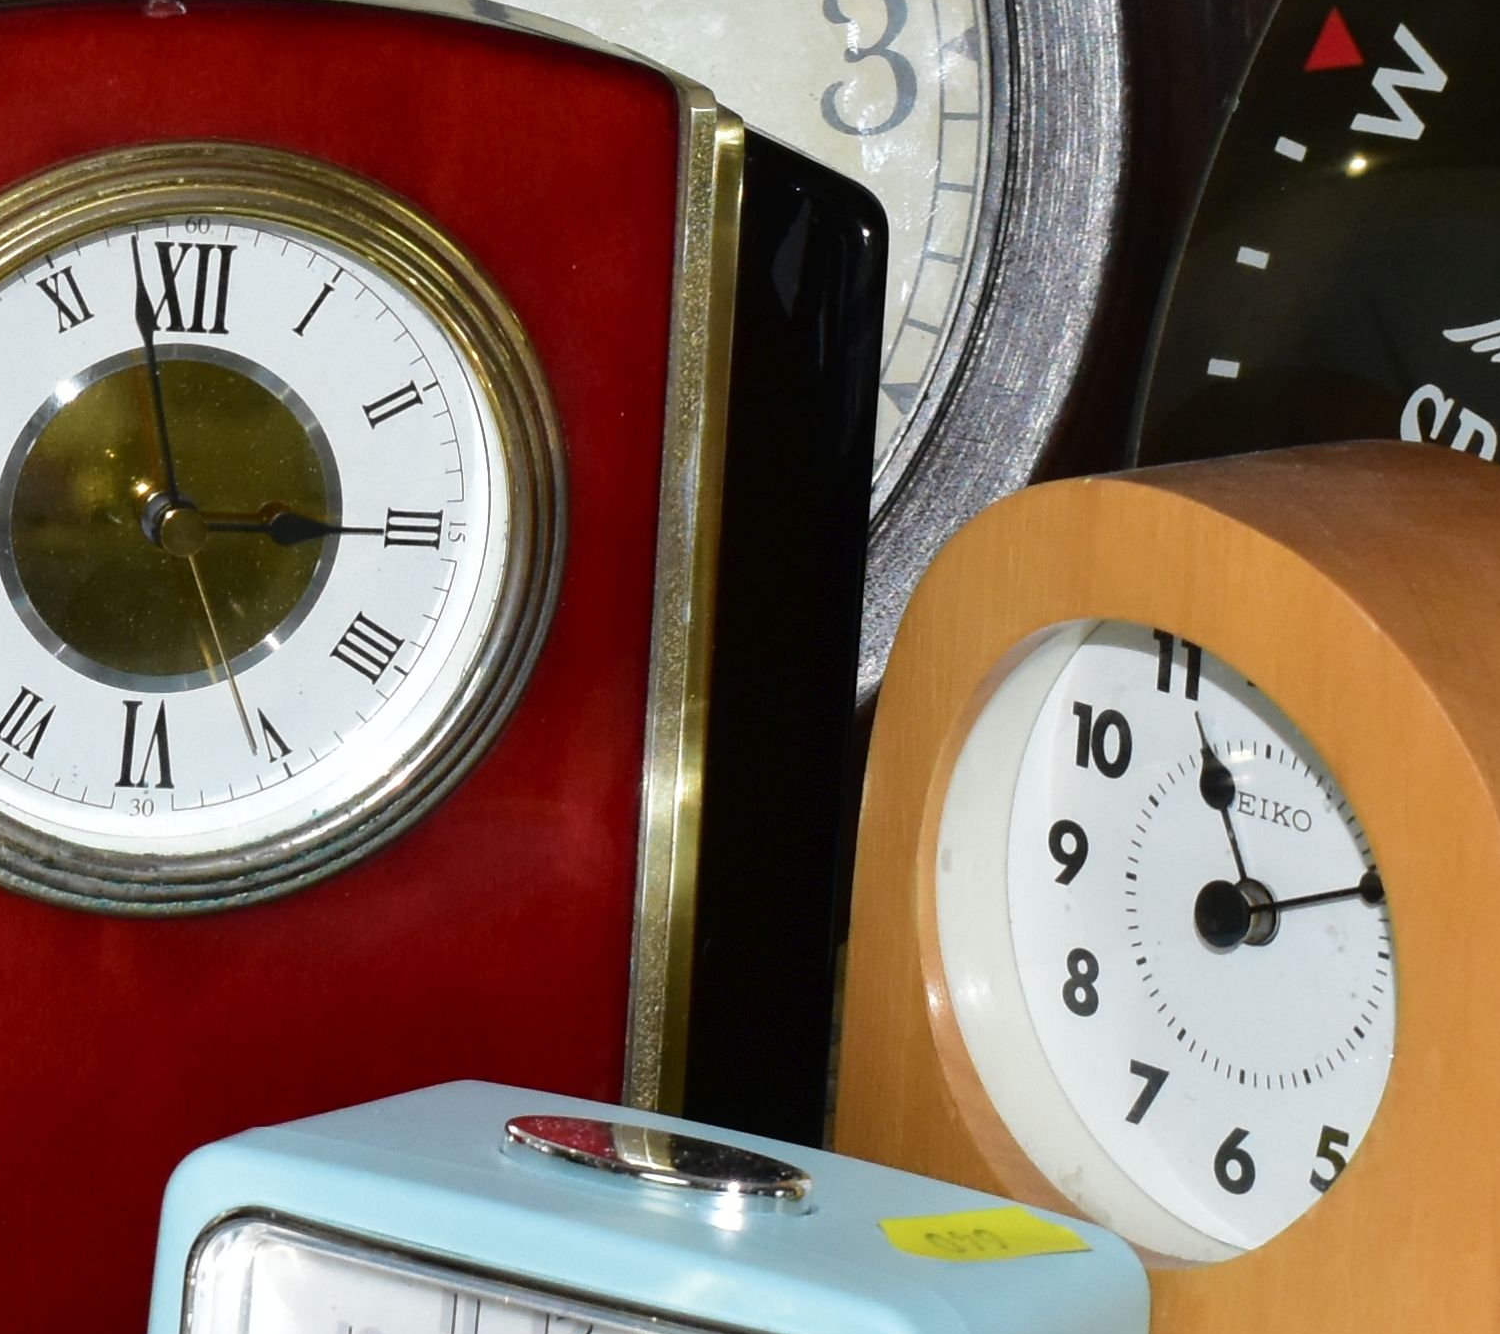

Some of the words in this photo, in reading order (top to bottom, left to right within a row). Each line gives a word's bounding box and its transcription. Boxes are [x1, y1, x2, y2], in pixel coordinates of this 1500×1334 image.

[1350, 23, 1448, 141] W
[185, 215, 211, 236] 60
[36, 265, 95, 334] XI
[149, 241, 238, 336] XII
[292, 281, 335, 336] I
[361, 379, 424, 430] II
[383, 506, 445, 549] III
[448, 519, 468, 545] 15
[328, 611, 405, 686] IIII
[1153, 628, 1202, 701] 11
[114, 699, 175, 790] VI
[256, 706, 293, 764] V
[1072, 702, 1133, 778] 10
[128, 798, 155, 819] 30
[1236, 791, 1313, 833] EIKO
[1048, 820, 1089, 885] 9
[1062, 947, 1099, 1017] 8
[1128, 1059, 1170, 1125] 7
[1213, 1127, 1257, 1195] 6
[1309, 1126, 1350, 1193] 5
